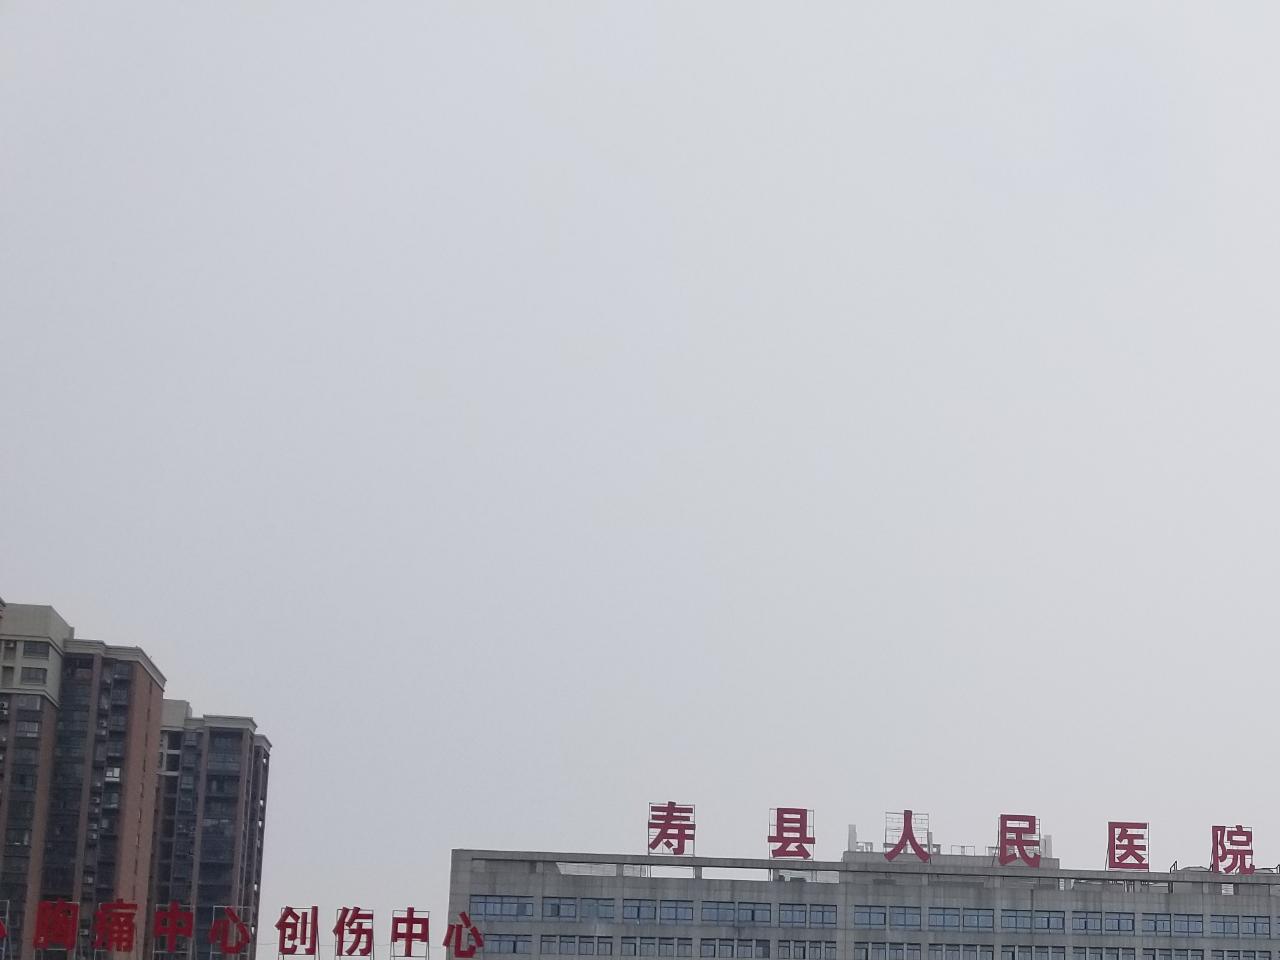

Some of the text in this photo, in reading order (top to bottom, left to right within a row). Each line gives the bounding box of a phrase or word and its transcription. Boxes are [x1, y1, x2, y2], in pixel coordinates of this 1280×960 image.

[648, 801, 1255, 875] 寿县人民医院
[33, 898, 485, 959] 胸痛中心 创伤中心
